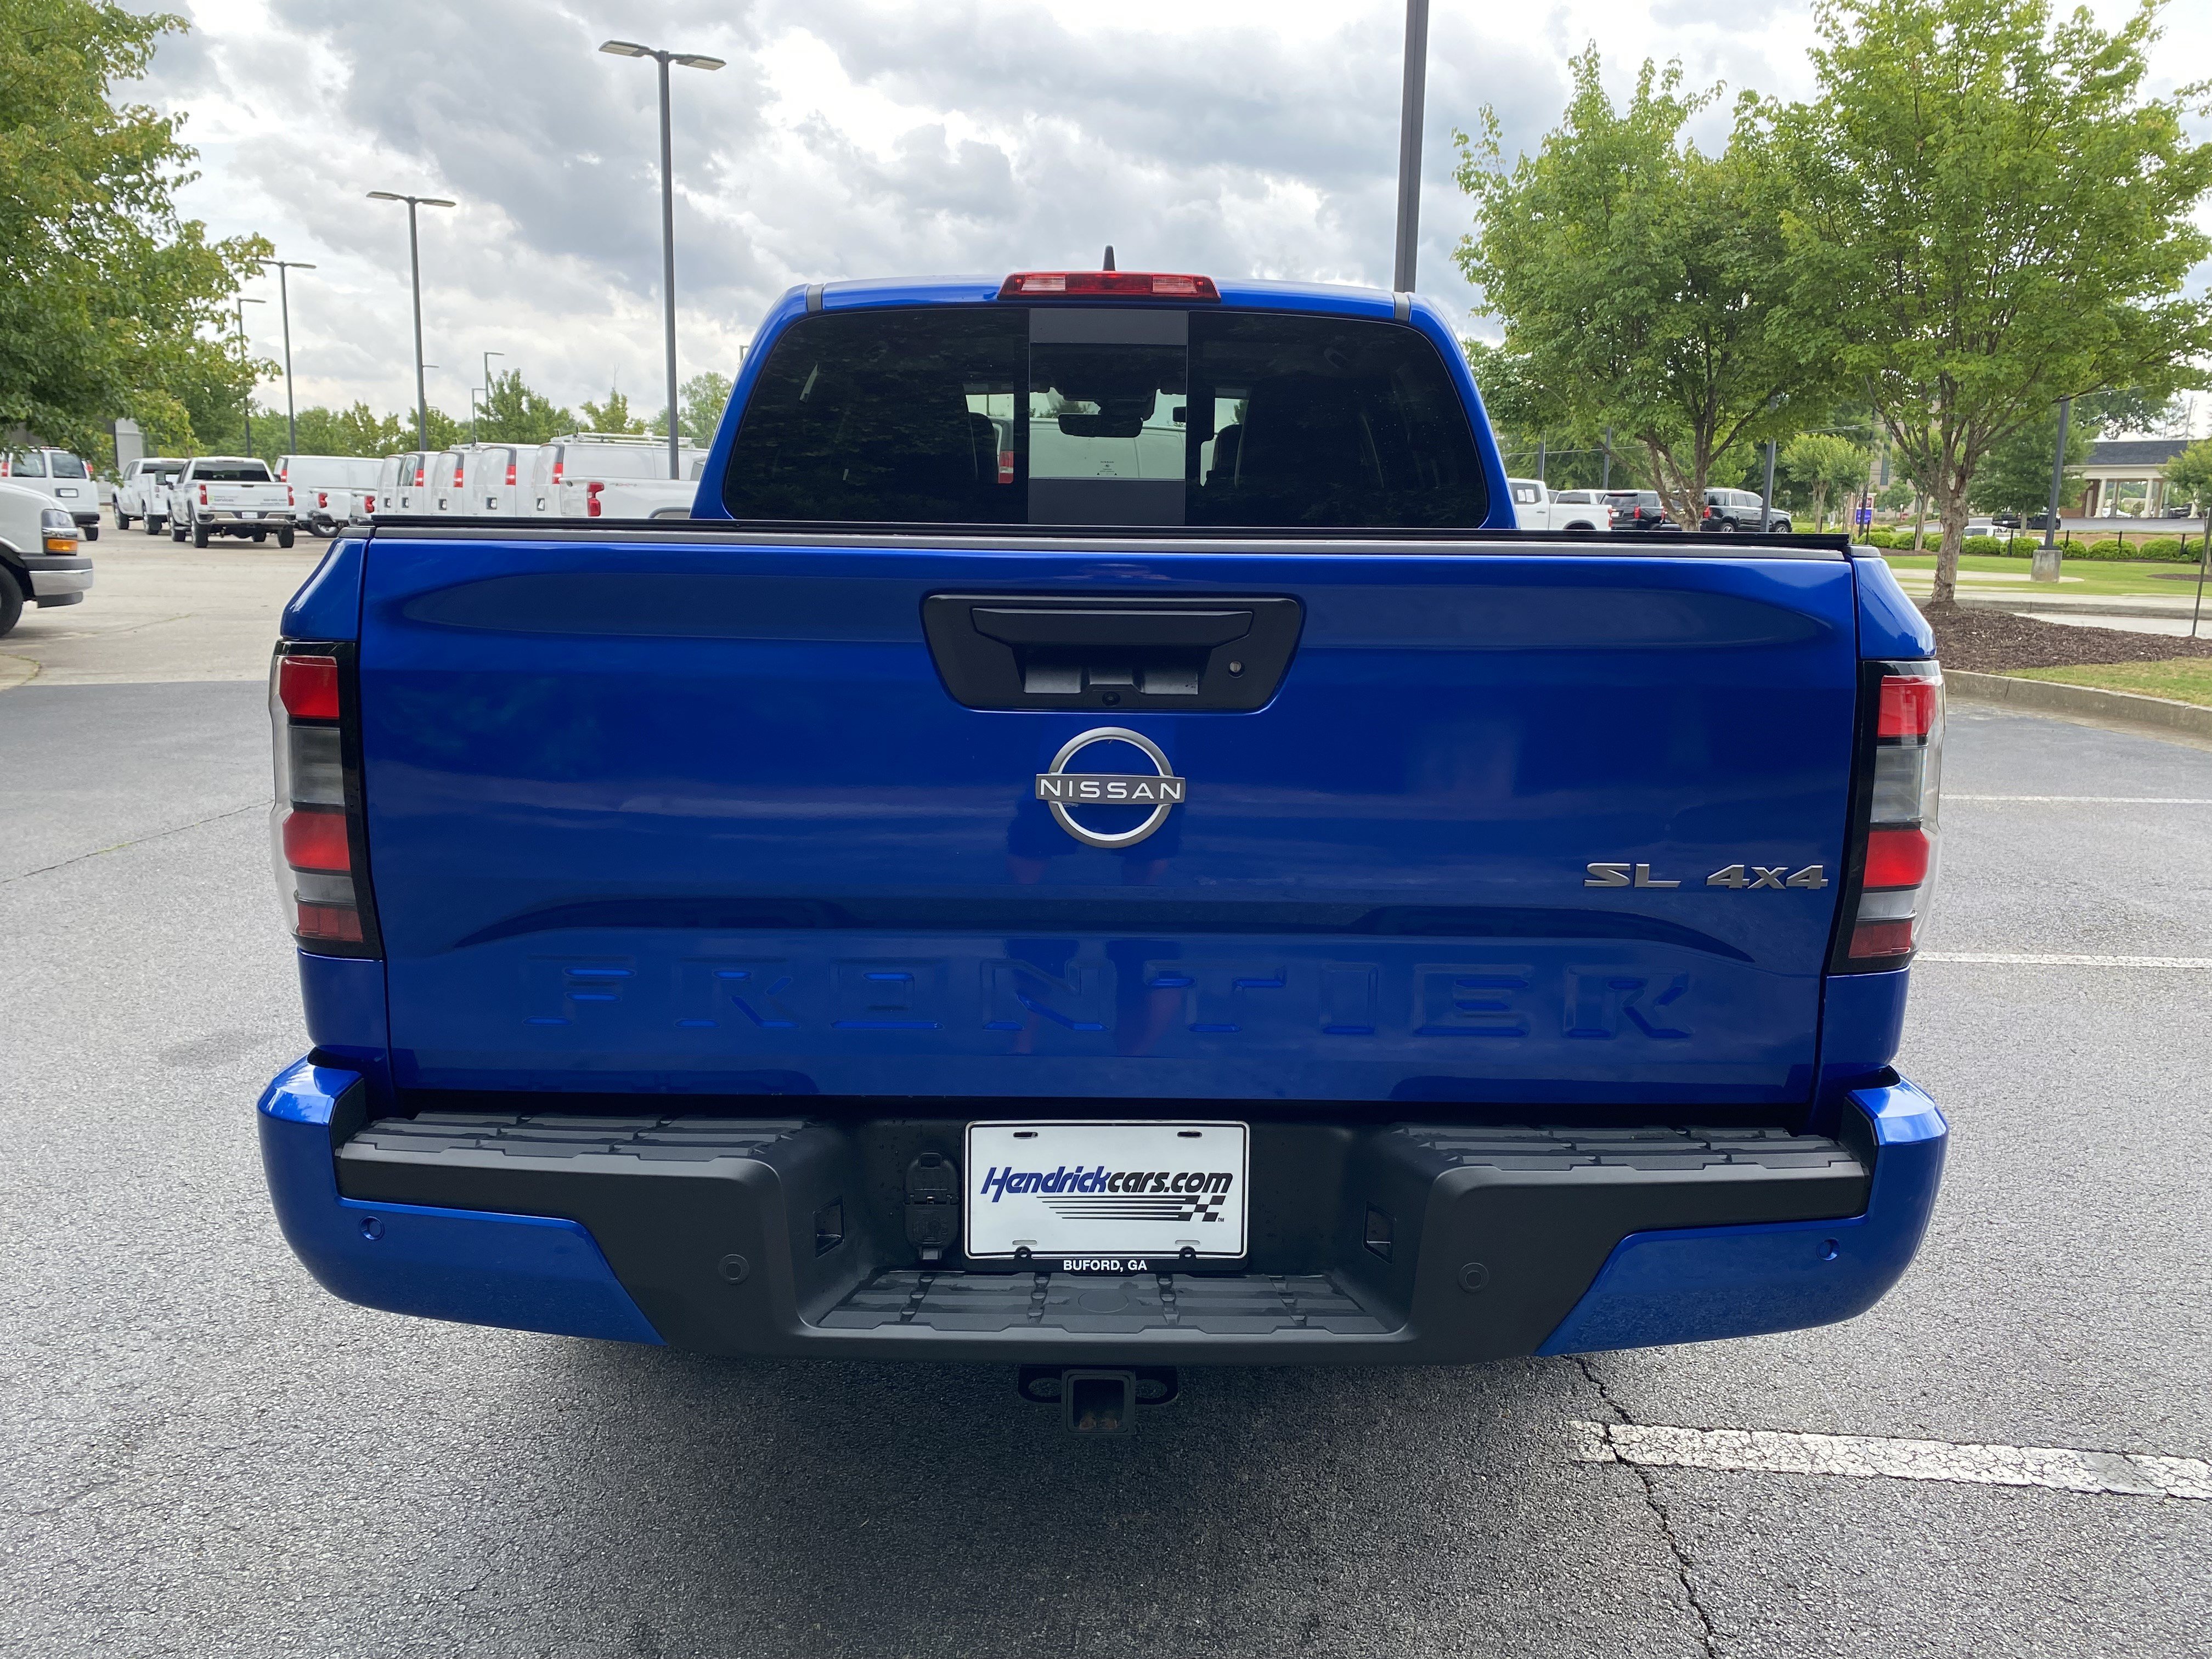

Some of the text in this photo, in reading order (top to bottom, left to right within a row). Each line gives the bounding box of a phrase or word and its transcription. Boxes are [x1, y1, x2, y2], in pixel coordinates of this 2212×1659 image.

[1040, 779, 1181, 799] NISSAN
[1584, 863, 1681, 888] SL
[520, 953, 1695, 1039] FRONTIER
[980, 1166, 1233, 1203] Hendrickcars.com
[1063, 1260, 1148, 1272] BUFORD, GA
